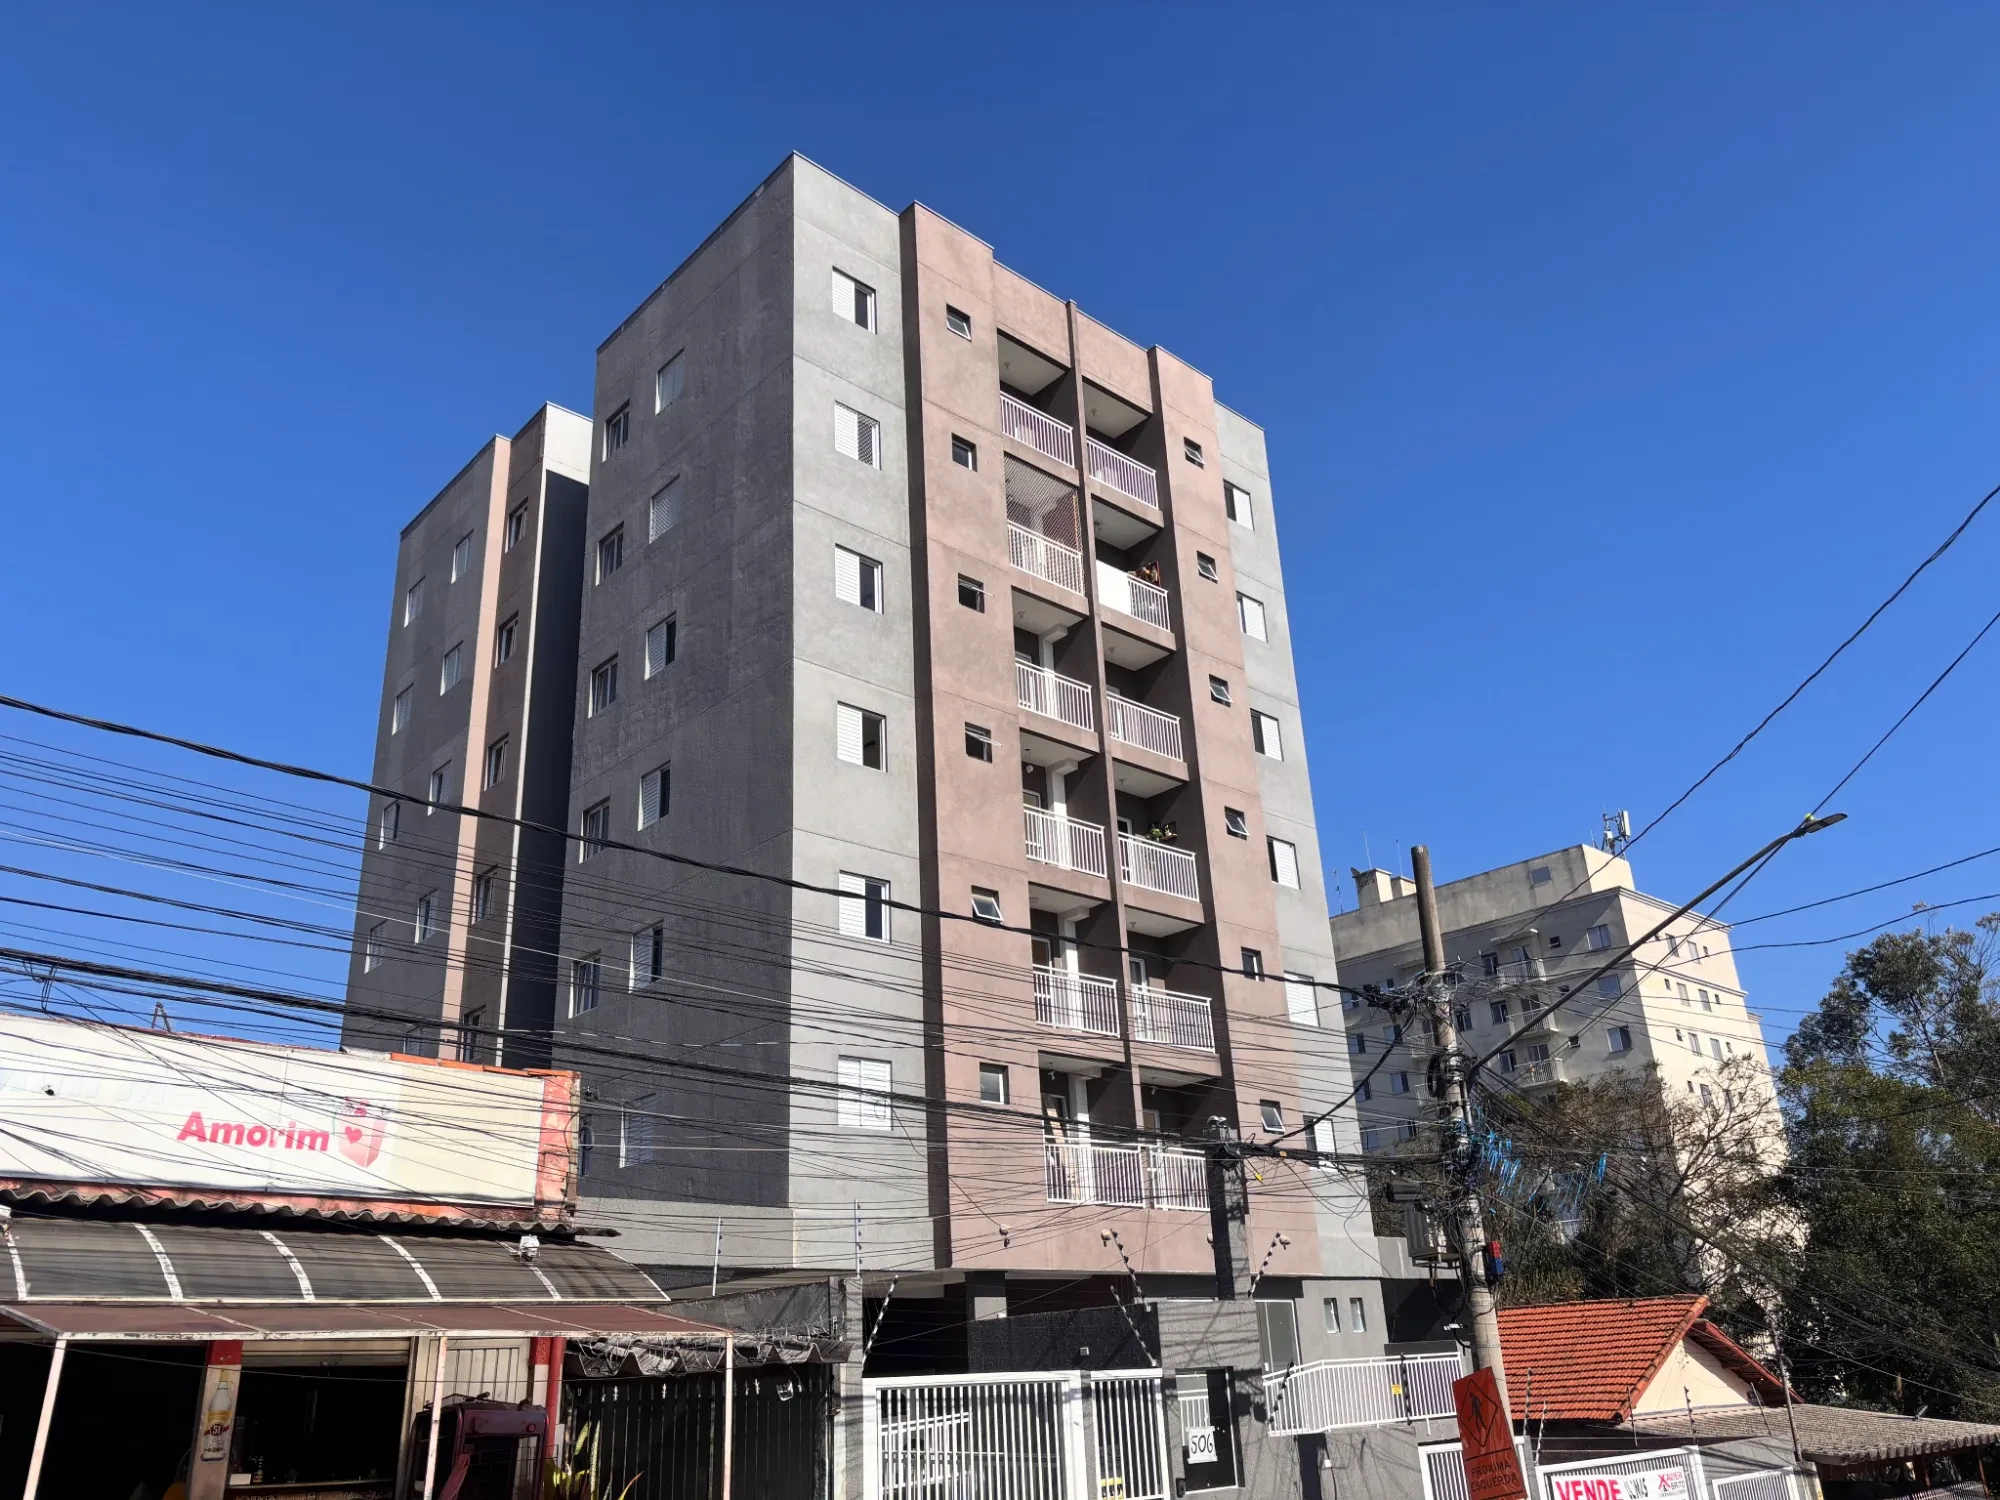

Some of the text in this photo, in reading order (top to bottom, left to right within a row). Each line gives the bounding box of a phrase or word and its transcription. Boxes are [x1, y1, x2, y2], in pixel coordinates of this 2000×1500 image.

[177, 1111, 329, 1151] Amorim
[212, 1424, 222, 1435] 51
[1191, 1434, 1213, 1454] 506
[1471, 1473, 1519, 1491] ESQUERDA
[1555, 1479, 1624, 1500] VENDE
